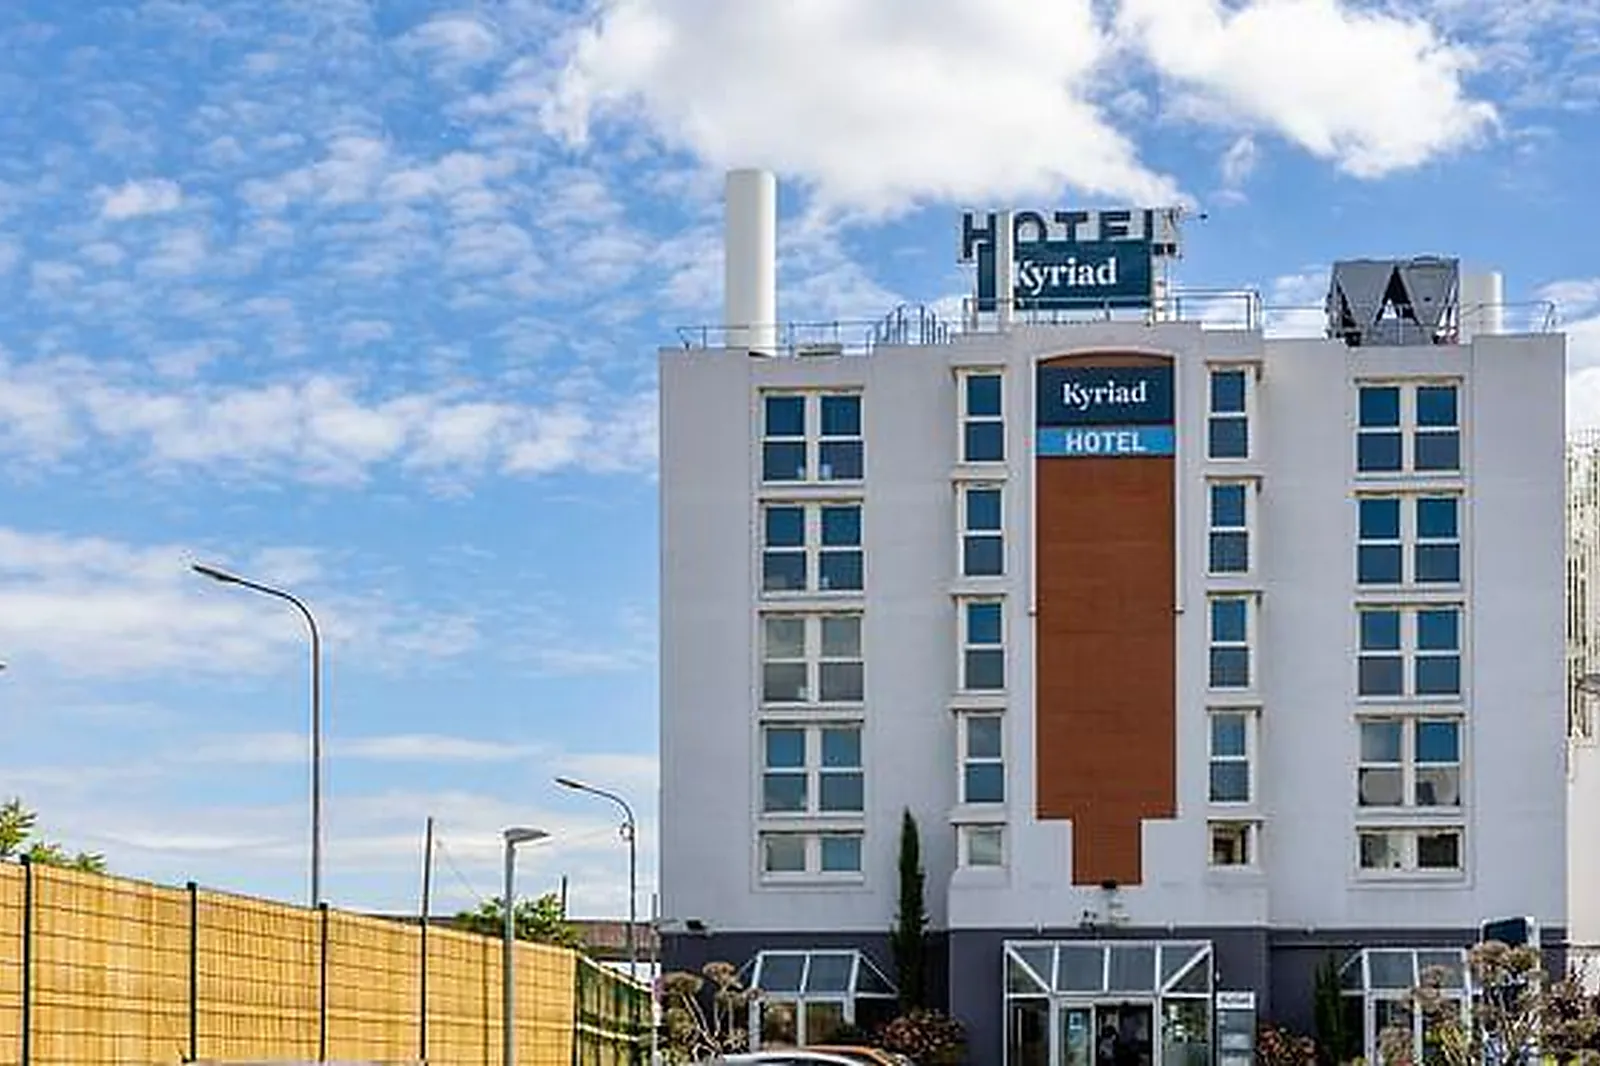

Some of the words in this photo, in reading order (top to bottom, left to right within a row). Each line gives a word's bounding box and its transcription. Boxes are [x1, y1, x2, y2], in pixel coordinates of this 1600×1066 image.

[1014, 257, 1117, 296] Kyriad
[1063, 380, 1146, 411] Kyriad
[1065, 431, 1147, 453] HOTEL
